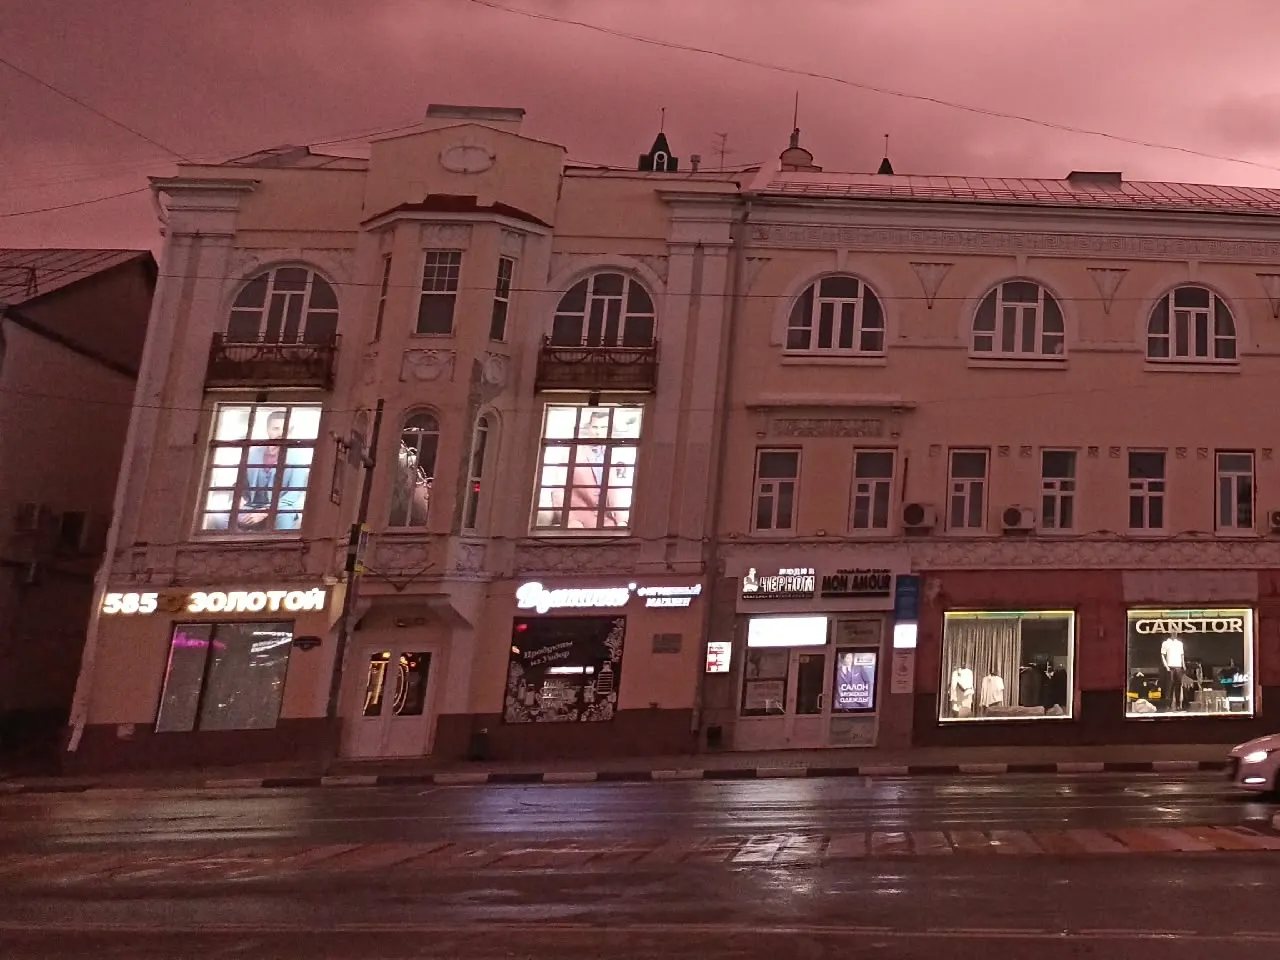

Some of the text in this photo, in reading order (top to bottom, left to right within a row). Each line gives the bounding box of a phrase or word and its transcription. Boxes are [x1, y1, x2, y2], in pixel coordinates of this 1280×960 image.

[759, 575, 815, 592] ЧЕРНОМ
[822, 574, 892, 591] MON AMOUR
[103, 588, 326, 613] 585 ЗОЛОТОЙ
[1135, 618, 1243, 634] GANSTOR
[840, 683, 868, 691] САЛОН
